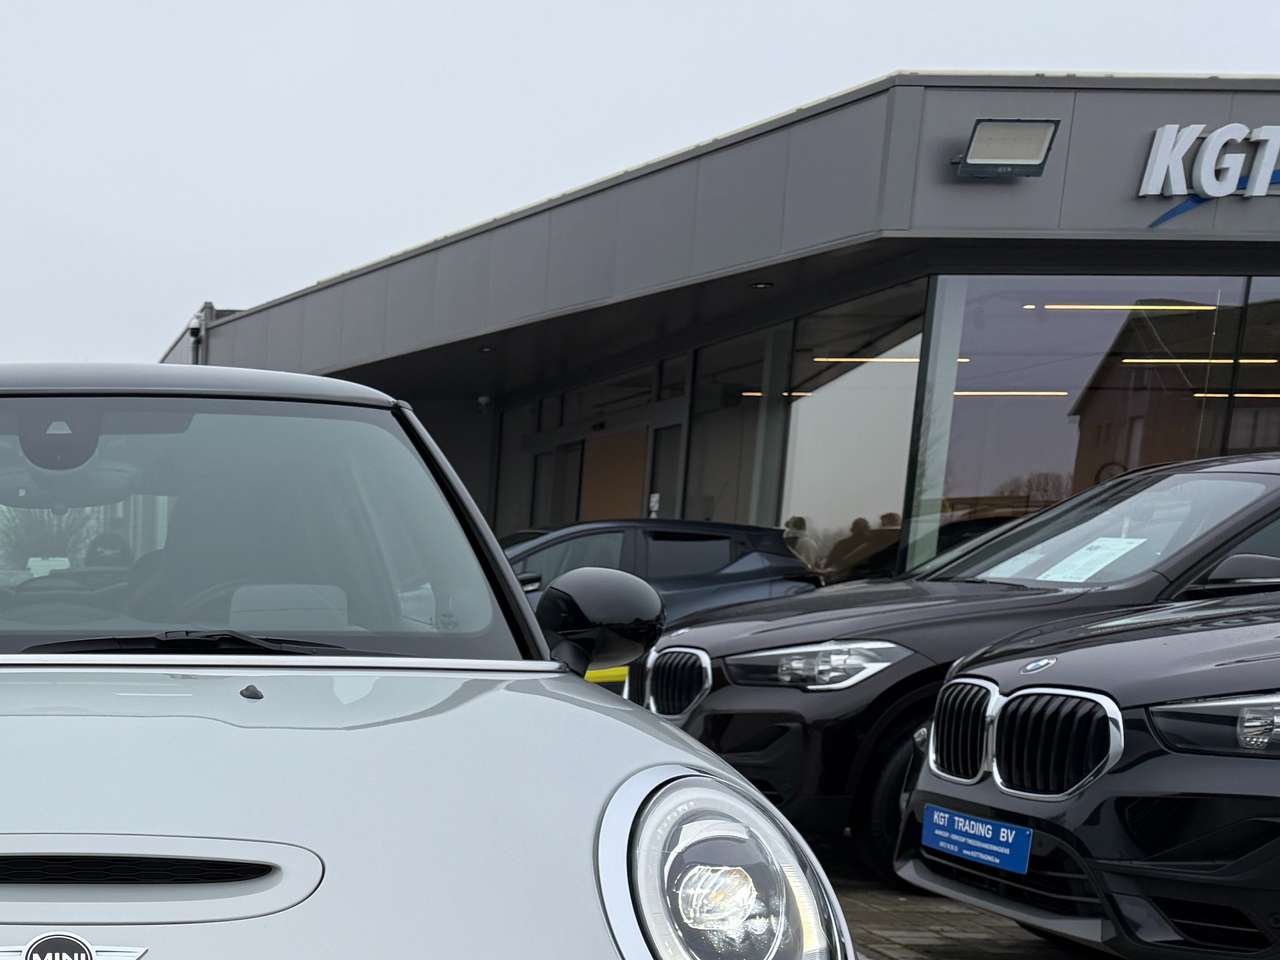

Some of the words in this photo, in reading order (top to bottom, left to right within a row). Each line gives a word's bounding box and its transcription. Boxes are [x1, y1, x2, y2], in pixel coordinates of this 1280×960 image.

[1139, 123, 1280, 198] KGT
[933, 811, 949, 827] KGT
[954, 816, 992, 838] TRADING
[1000, 828, 1015, 843] BV
